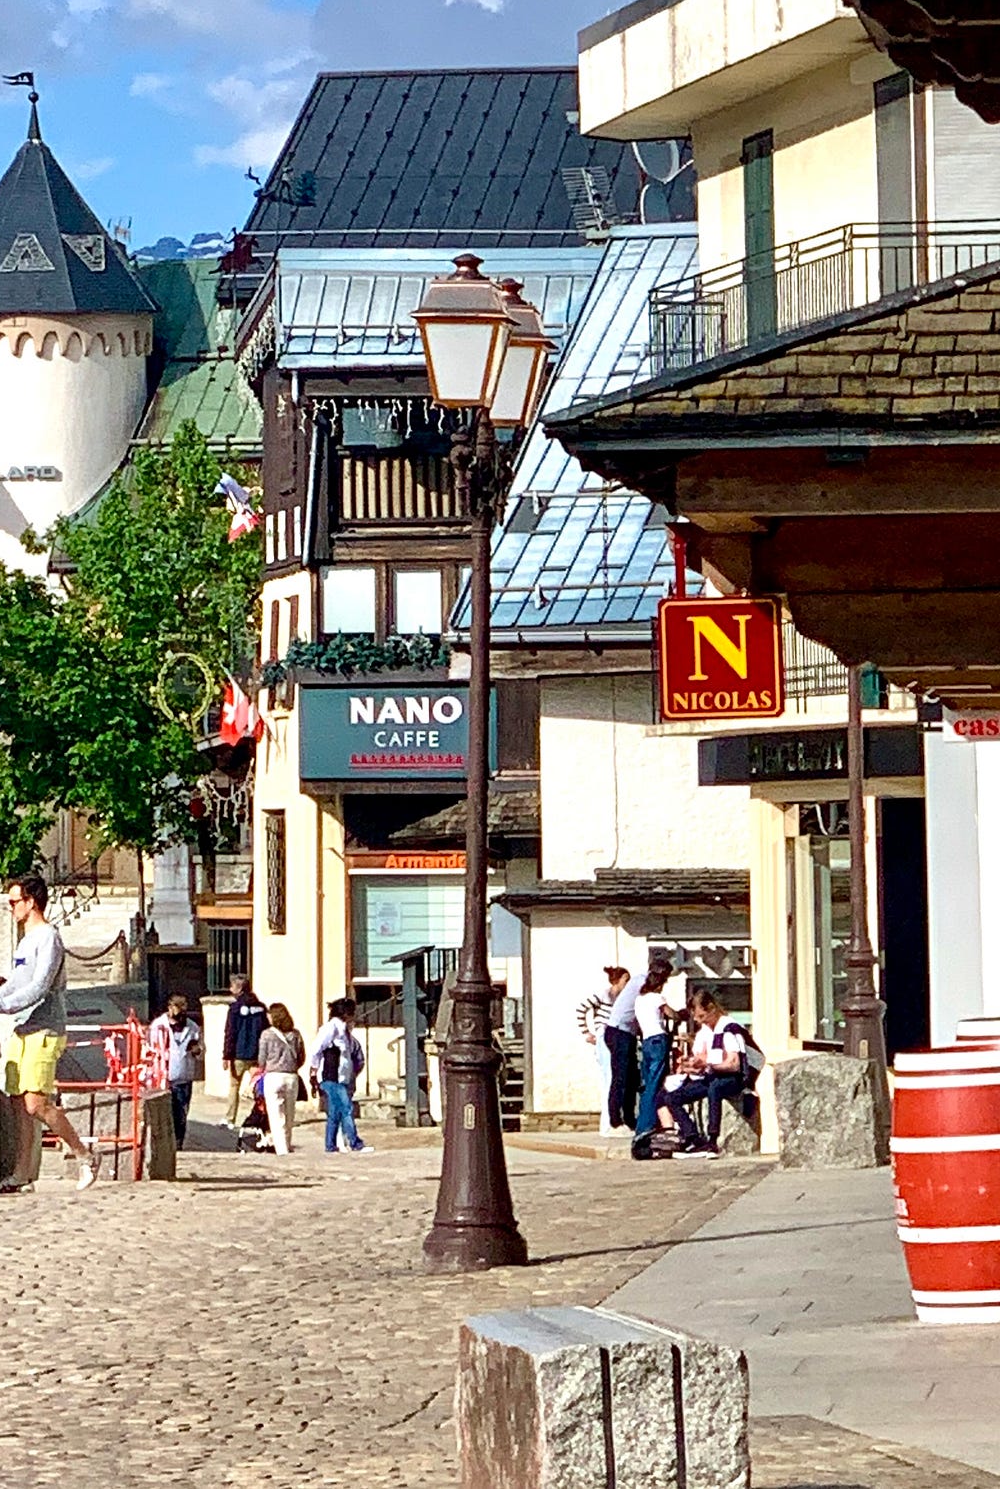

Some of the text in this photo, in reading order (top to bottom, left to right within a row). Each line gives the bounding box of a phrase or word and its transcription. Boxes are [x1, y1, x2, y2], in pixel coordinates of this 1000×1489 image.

[686, 614, 752, 681] N
[349, 695, 463, 725] NANO
[672, 690, 772, 710] NICOLAS
[374, 730, 440, 748] CAFFE
